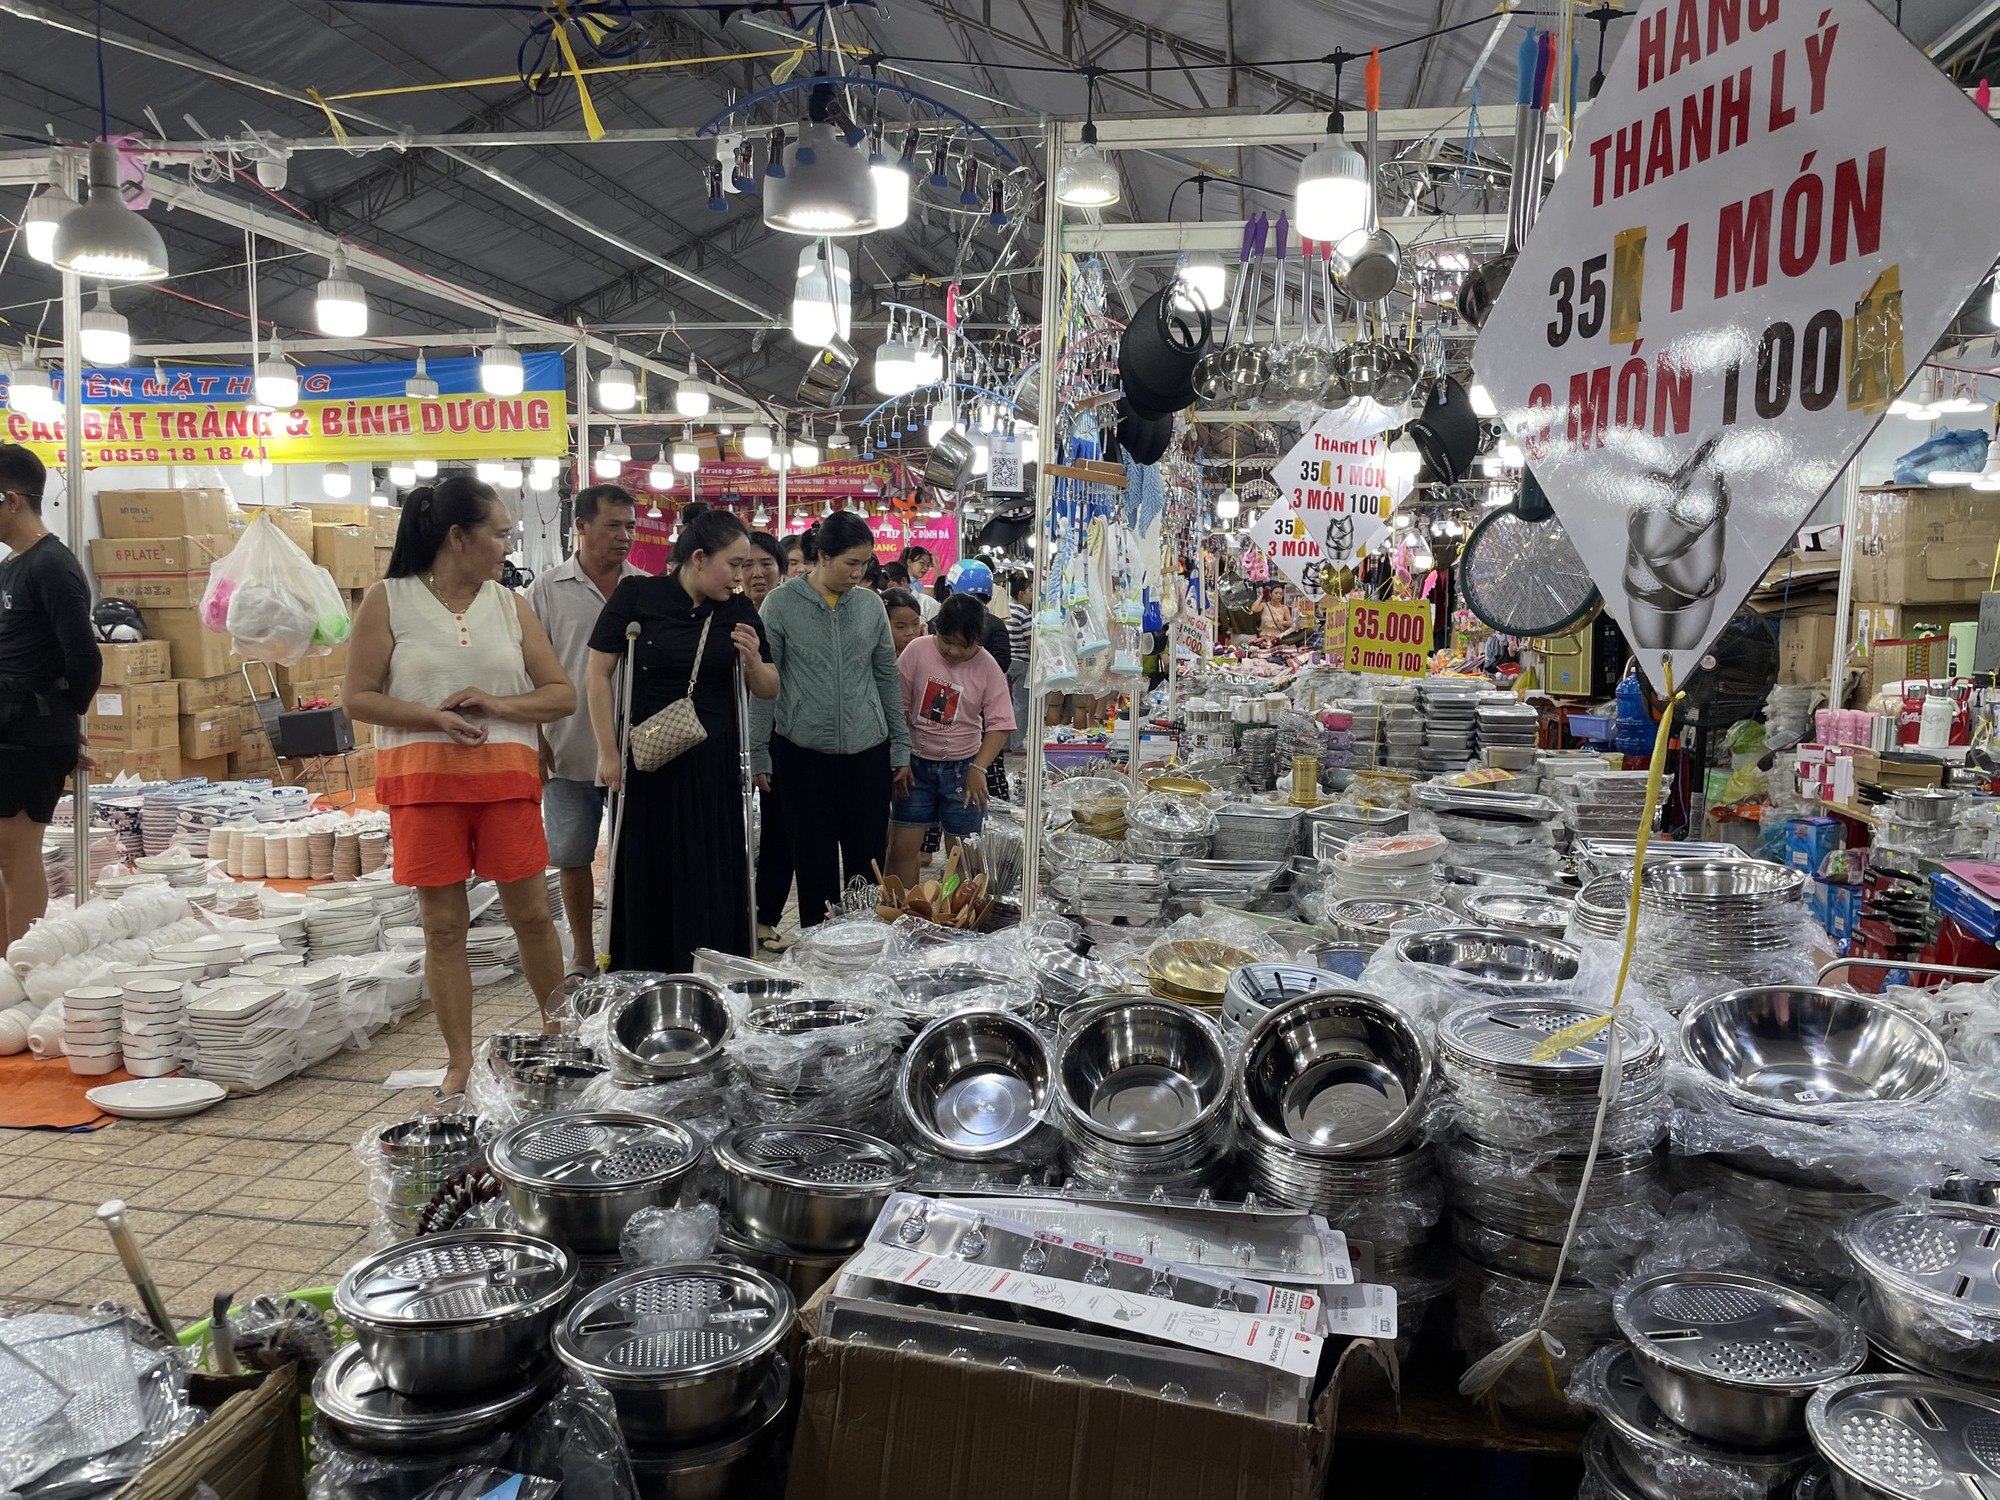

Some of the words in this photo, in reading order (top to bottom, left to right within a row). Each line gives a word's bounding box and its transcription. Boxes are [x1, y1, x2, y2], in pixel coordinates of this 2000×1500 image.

[1590, 66, 1752, 208] THANH
[1768, 8, 1839, 132] LÝ
[1667, 222, 1690, 313] 1
[1714, 146, 1886, 300] MÓN
[142, 372, 219, 399] MẶT
[227, 375, 331, 395] HG
[1567, 338, 1692, 453] MÓN
[83, 406, 147, 442] BÁT
[156, 404, 272, 441] TRÀNG
[286, 408, 312, 437] &
[322, 401, 411, 436] BÌNH
[422, 398, 551, 432] DƯƠNG
[100, 448, 160, 461] 0859
[167, 447, 196, 461] 18
[204, 446, 233, 460] 18
[1315, 433, 1357, 455] THANH
[1362, 436, 1377, 456] LÝ
[1336, 465, 1343, 484] 1
[1349, 463, 1385, 487] MÓN
[1293, 487, 1302, 508] 3
[1307, 487, 1345, 511] MÓN
[886, 529, 901, 540] KẸP
[938, 527, 950, 539] ĐÁ
[115, 550, 122, 560] 6
[124, 549, 161, 560] PLATE
[1268, 541, 1277, 557] 3
[1282, 538, 1319, 556] MÓN
[1183, 626, 1203, 640] MÓN
[1354, 607, 1424, 645] 35.000
[1351, 646, 1359, 665] 3
[1363, 649, 1392, 669] món
[1397, 651, 1422, 672] 100
[102, 723, 123, 731] CHINA
[1280, 1290, 1289, 1310] HOOK
